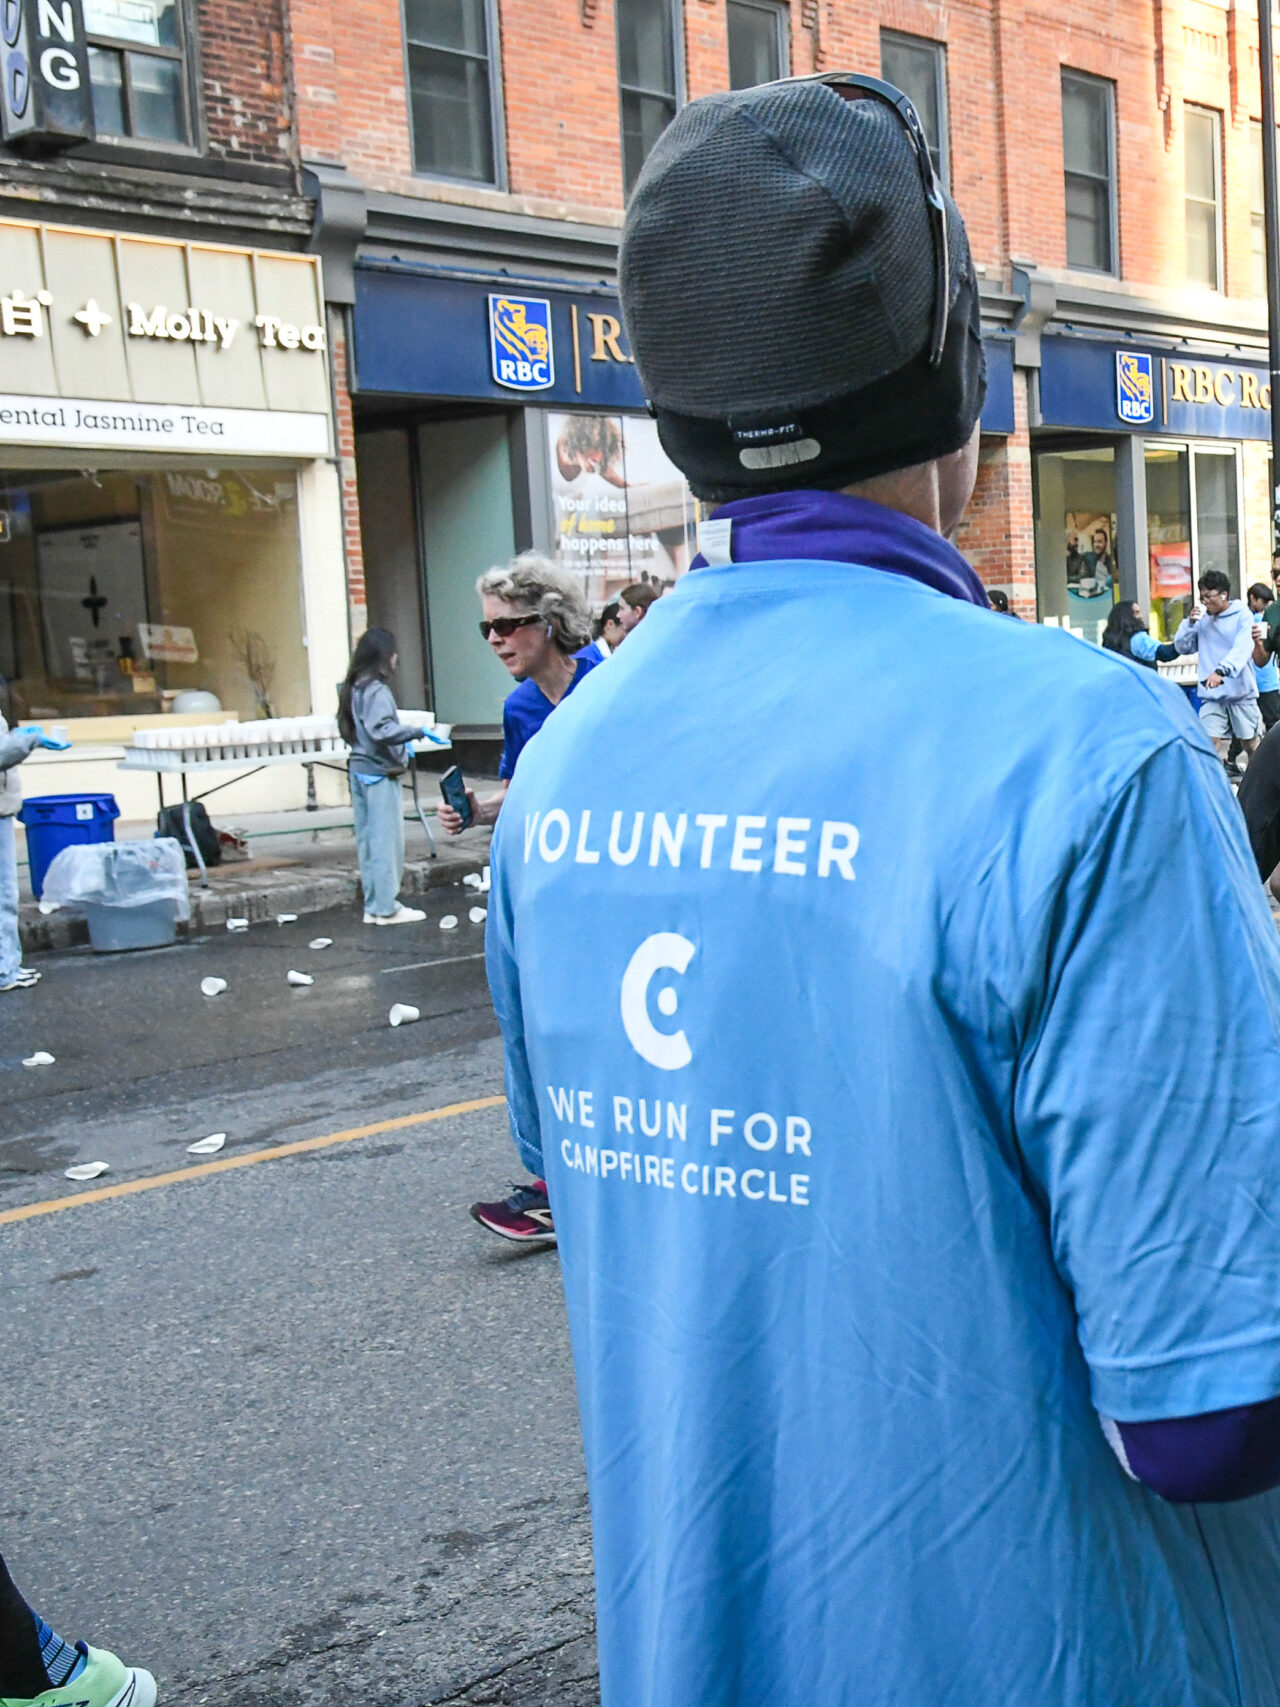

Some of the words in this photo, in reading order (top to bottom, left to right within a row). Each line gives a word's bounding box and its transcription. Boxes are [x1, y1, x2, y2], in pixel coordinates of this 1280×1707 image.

[127, 302, 240, 350] Molly
[255, 314, 325, 350] Tea
[500, 359, 549, 383] RBC
[1170, 363, 1236, 406] RBC
[0, 408, 65, 427] ental
[75, 409, 174, 433] Jasmine
[181, 415, 225, 436] Tea
[1122, 401, 1150, 417] RBC
[557, 495, 592, 512] Your
[594, 496, 627, 512] idea
[560, 534, 625, 555] happens
[628, 533, 661, 551] here
[523, 807, 860, 881] VOLUNTEER
[547, 1084, 596, 1130] WE
[612, 1095, 687, 1142] RUN
[709, 1108, 813, 1157] FOR
[561, 1138, 675, 1189] CAMPFIRE
[681, 1162, 810, 1206] CIRCLE
